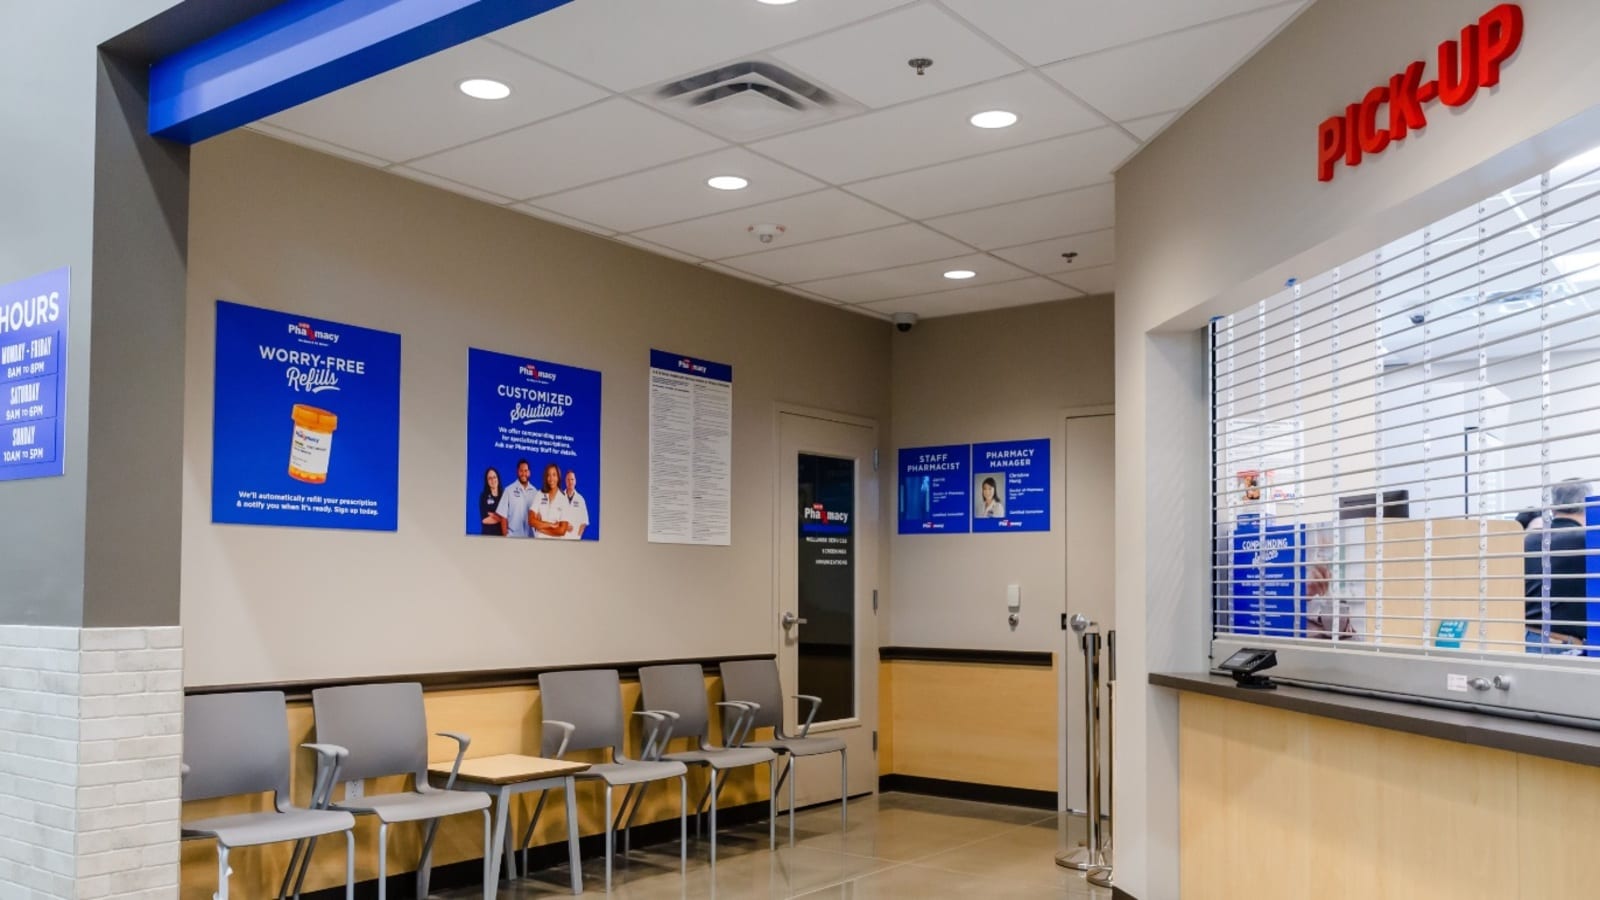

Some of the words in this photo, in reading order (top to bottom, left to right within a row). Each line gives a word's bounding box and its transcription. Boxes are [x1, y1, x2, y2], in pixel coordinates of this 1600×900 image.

[1318, 3, 1523, 182] PICK-UP
[0, 291, 59, 333] HOURS
[2, 342, 25, 365] MONDAY
[30, 336, 52, 359] FRIDAY
[259, 344, 365, 374] WORRY-FREE
[286, 366, 340, 392] Refills
[10, 382, 40, 405] SATURDAY
[497, 384, 573, 406] CUSTOMIZED
[510, 402, 565, 424] Solutions
[13, 426, 35, 446] SUNDAY
[521, 430, 554, 440] compounding
[515, 443, 539, 453] Pharmacy
[919, 453, 948, 463] STAFF
[986, 448, 1035, 459] PHARMACY
[907, 462, 960, 472] PHARMACIST
[990, 458, 1031, 468] MANAGER
[236, 500, 242, 508] &
[243, 501, 265, 510] notify
[281, 503, 300, 511] when
[334, 506, 349, 515] Sign
[238, 491, 257, 499] We'll
[258, 493, 305, 503] automatically
[339, 499, 377, 507] prescription
